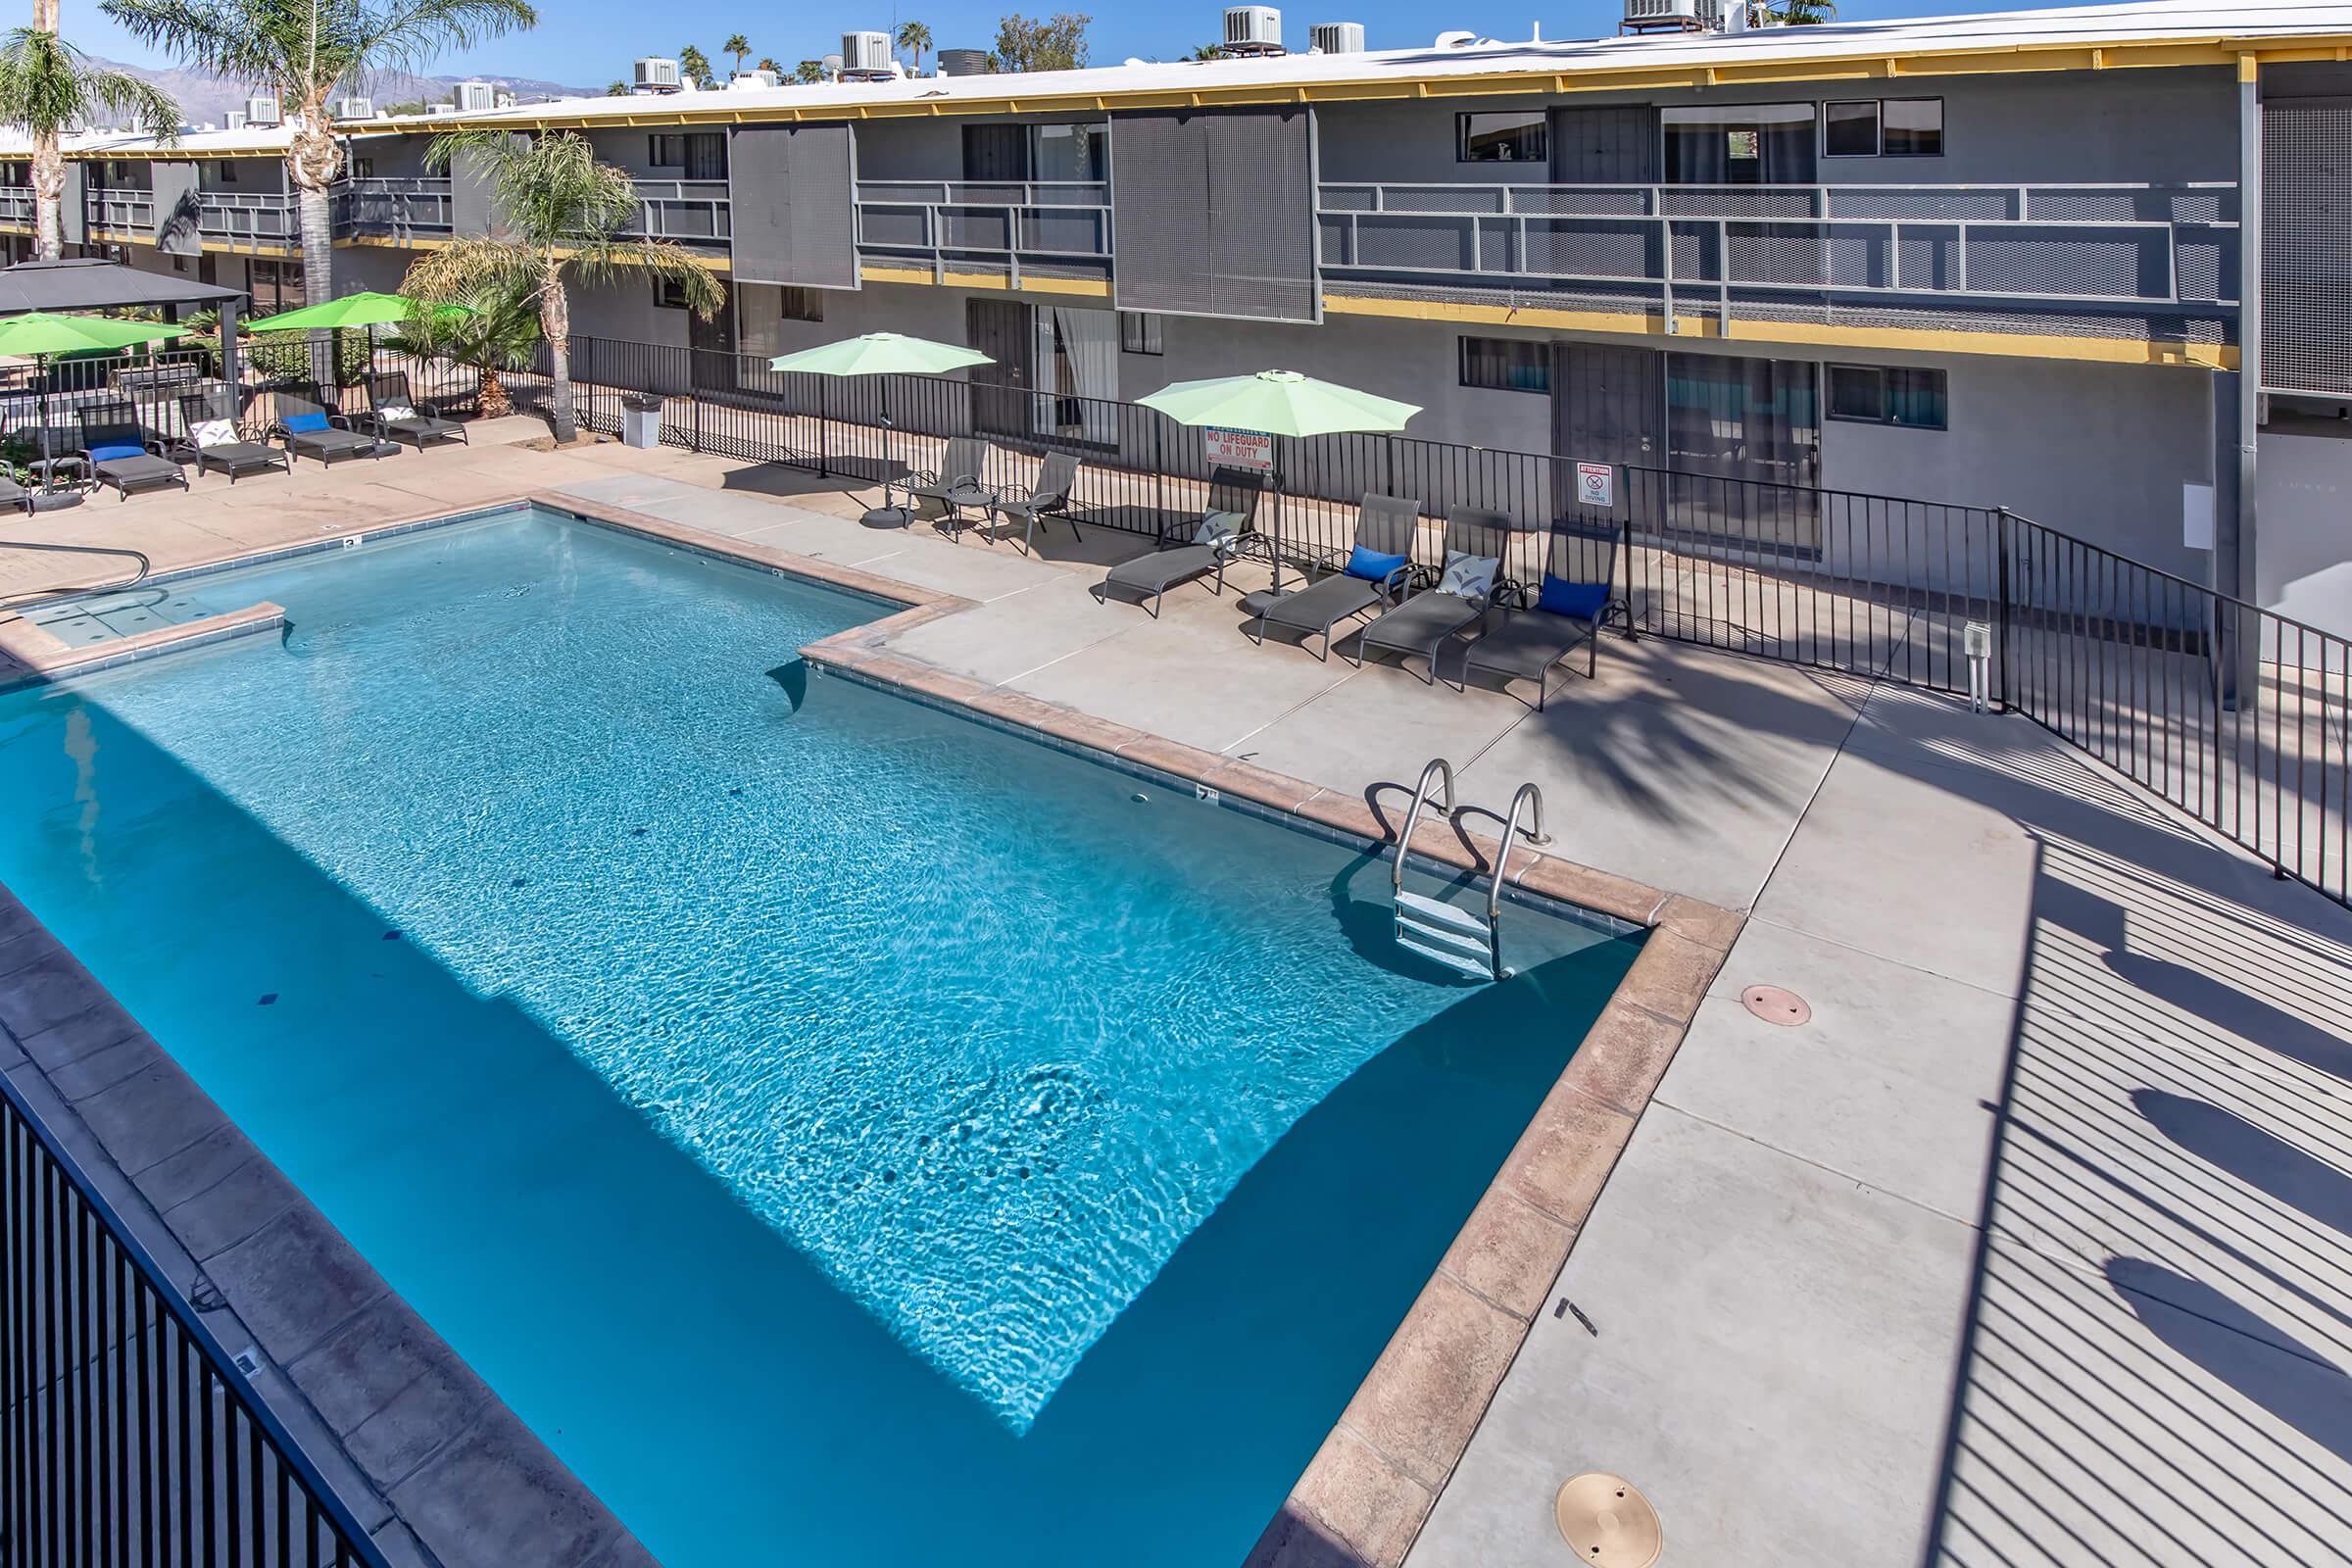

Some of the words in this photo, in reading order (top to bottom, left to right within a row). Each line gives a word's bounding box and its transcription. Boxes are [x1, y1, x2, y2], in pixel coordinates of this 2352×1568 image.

[1207, 431, 1220, 442] NO
[1223, 433, 1269, 448] LIFEGUARD
[1220, 444, 1232, 456] ON
[1235, 446, 1258, 459] DUTY
